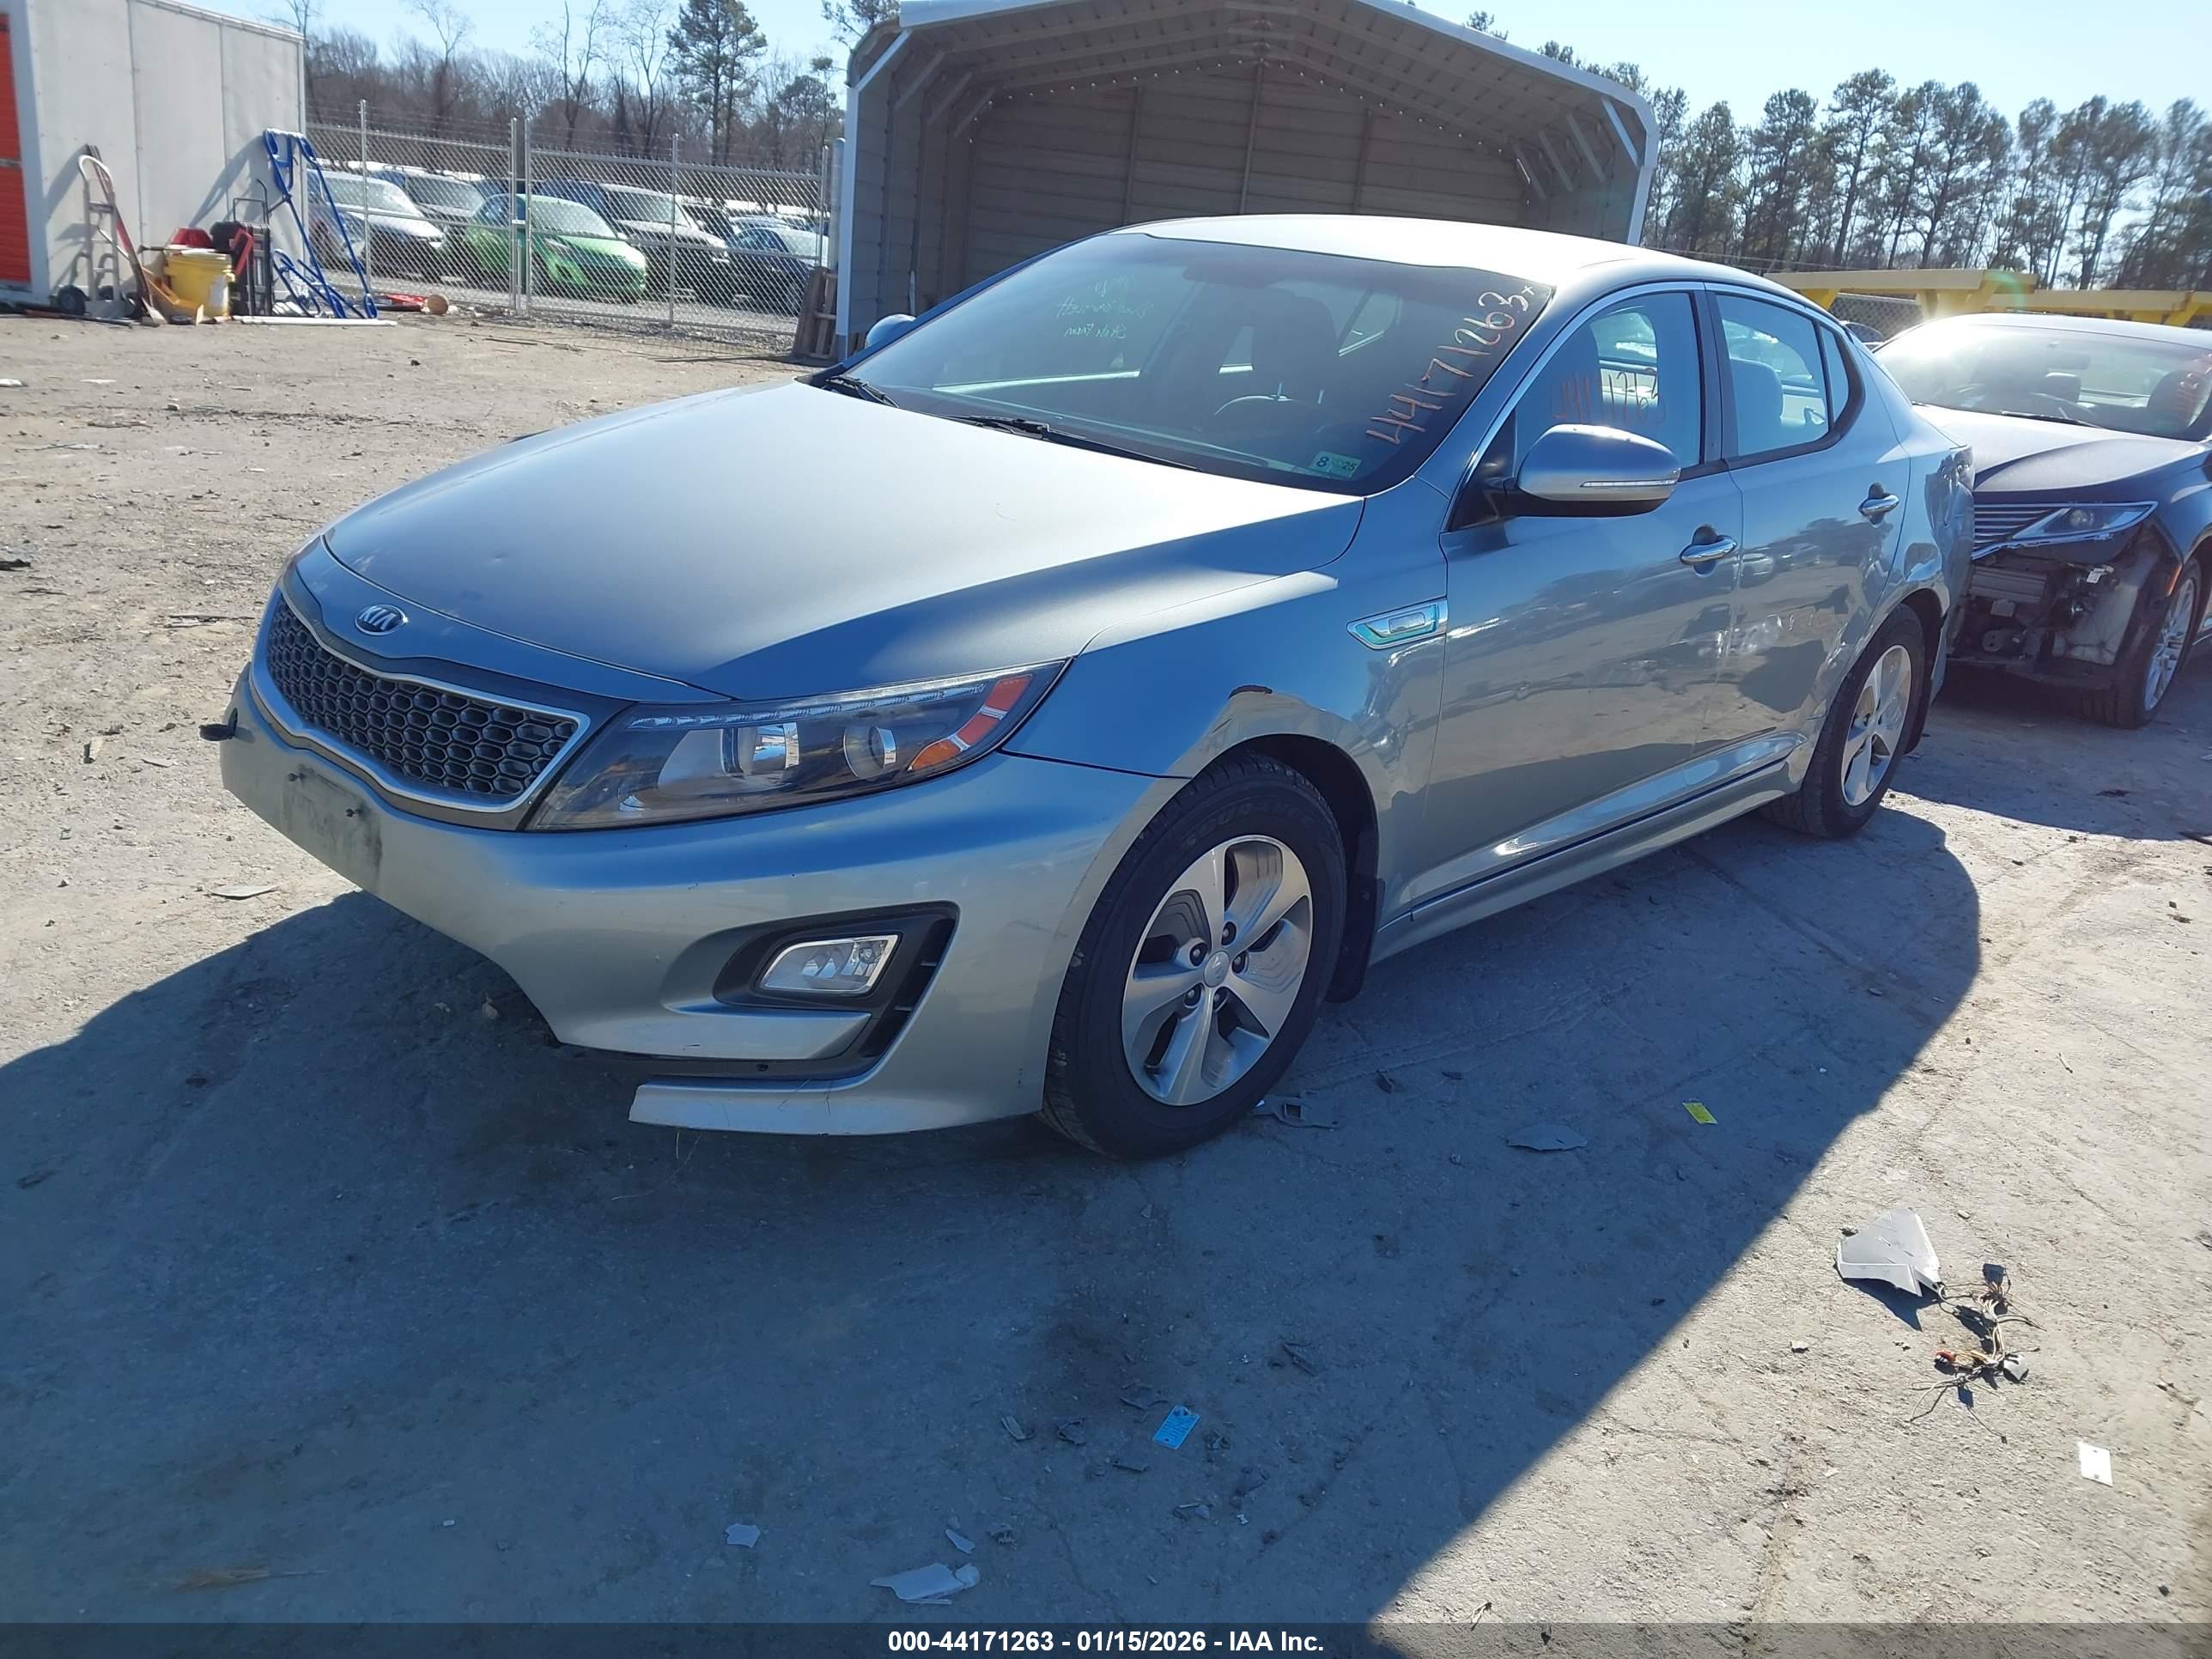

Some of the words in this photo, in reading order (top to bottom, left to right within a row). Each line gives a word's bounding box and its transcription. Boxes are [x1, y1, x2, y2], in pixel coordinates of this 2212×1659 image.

[1316, 456, 1329, 467] 8
[1341, 461, 1358, 471] 25
[357, 605, 398, 632] KIA
